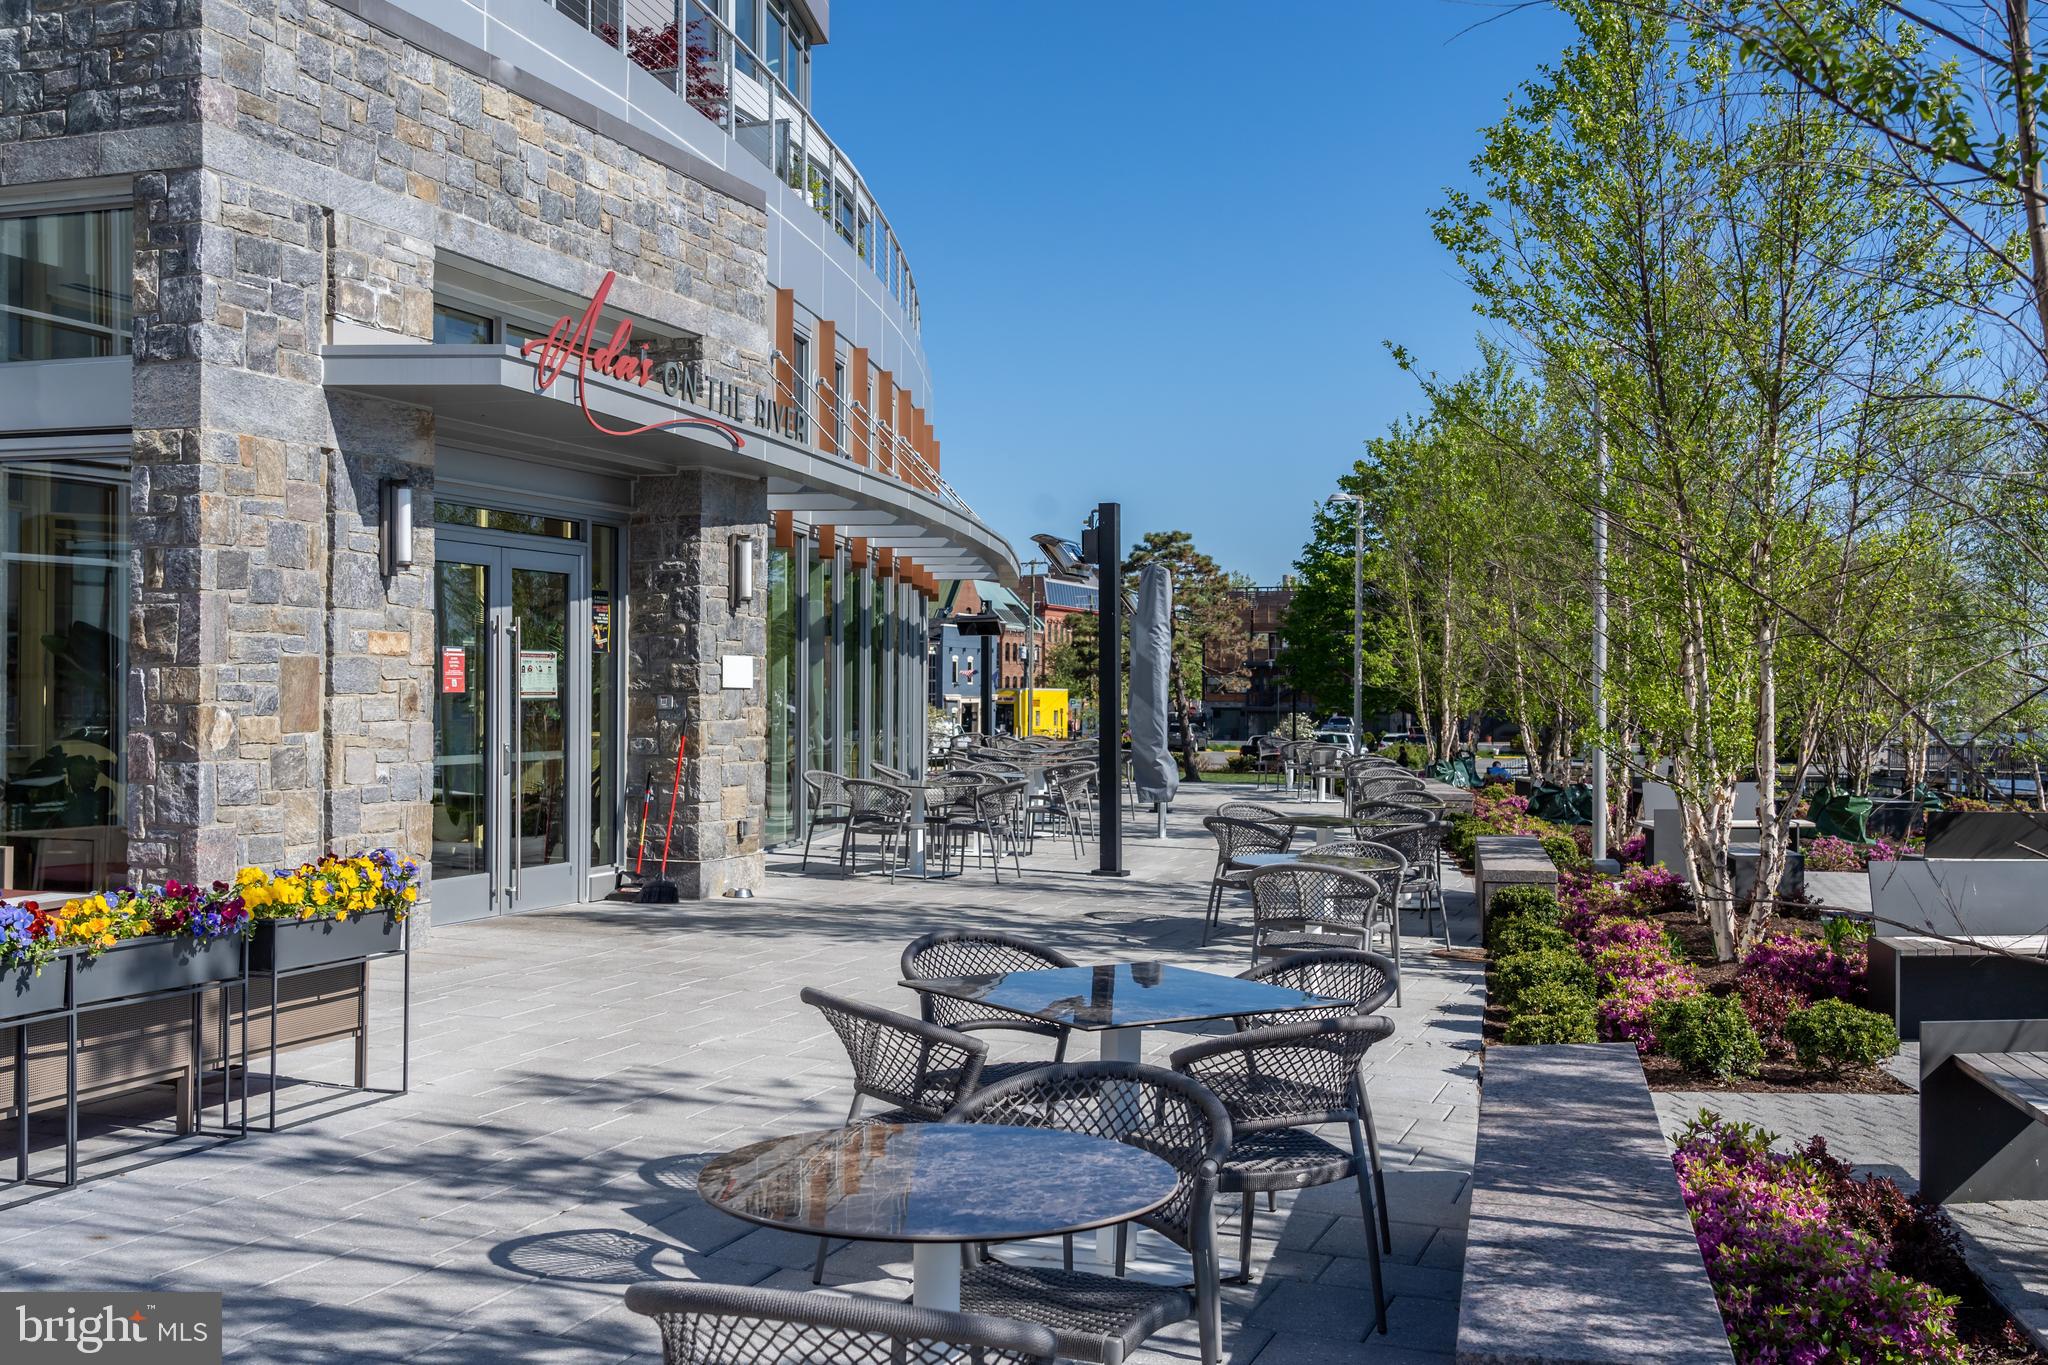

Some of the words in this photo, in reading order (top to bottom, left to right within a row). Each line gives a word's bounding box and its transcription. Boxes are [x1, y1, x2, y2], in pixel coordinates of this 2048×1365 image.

[663, 361, 698, 405] ON
[706, 375, 747, 423] THE
[755, 394, 805, 443] RIVER
